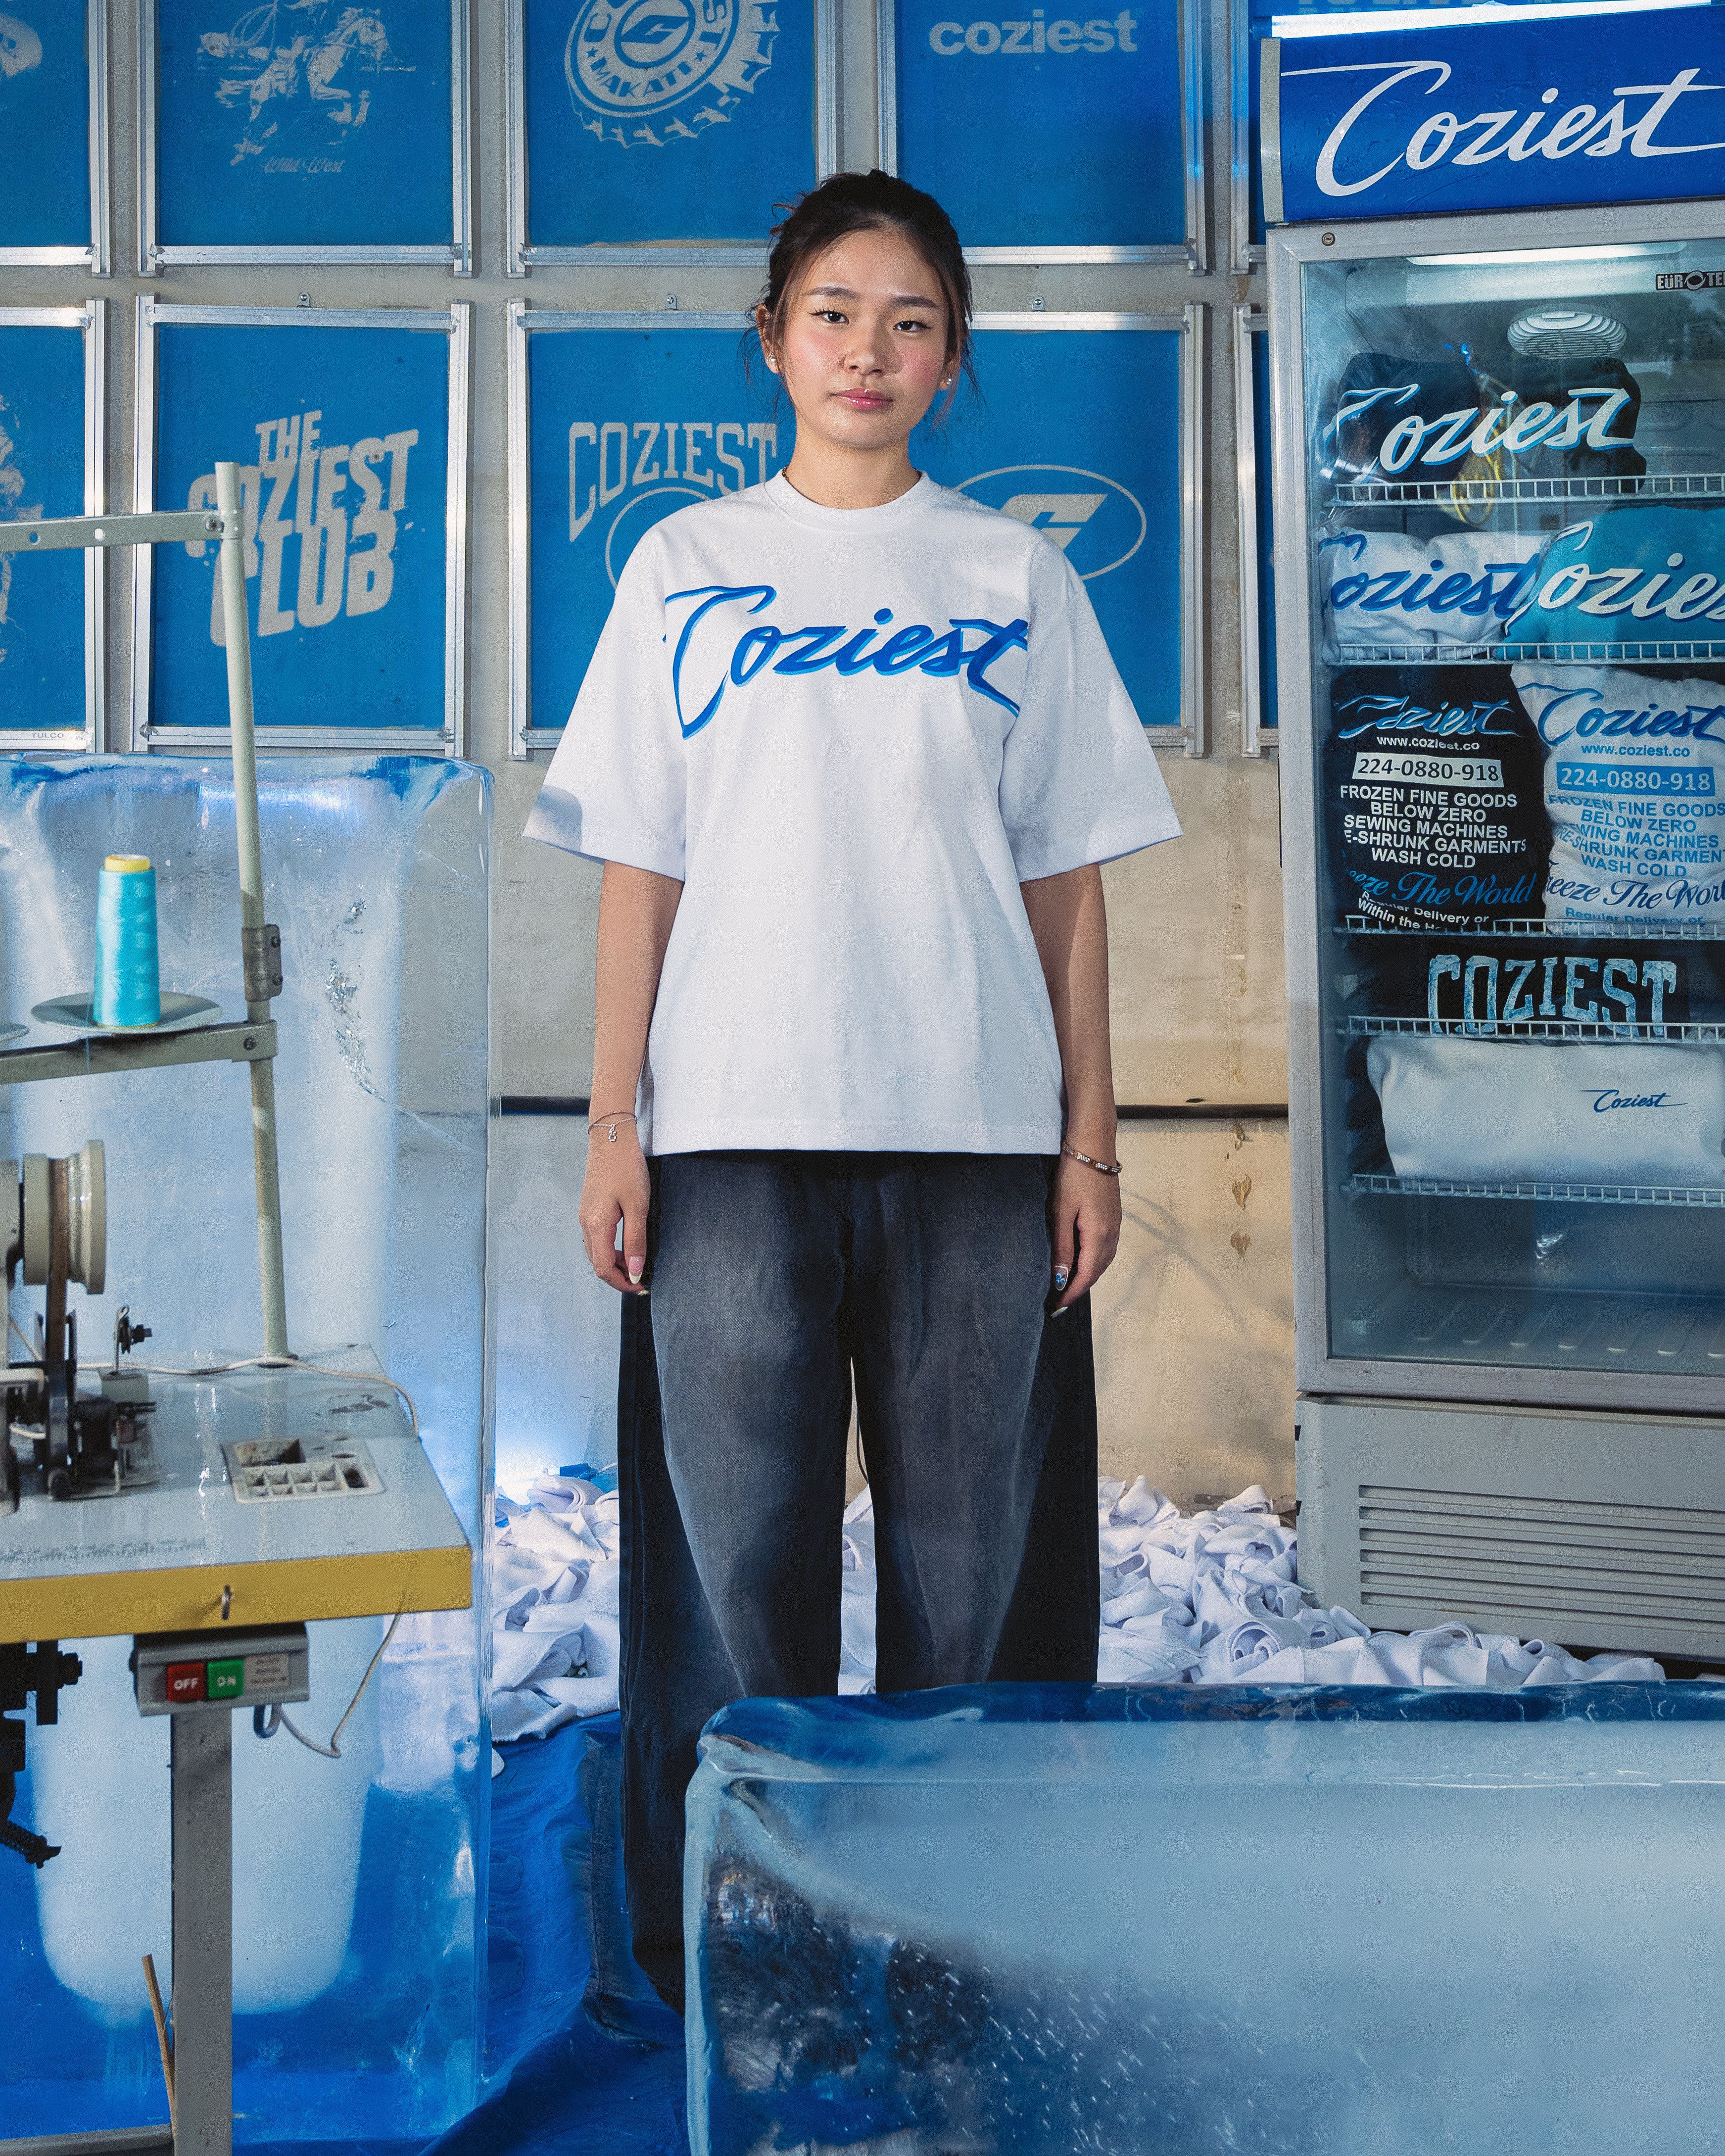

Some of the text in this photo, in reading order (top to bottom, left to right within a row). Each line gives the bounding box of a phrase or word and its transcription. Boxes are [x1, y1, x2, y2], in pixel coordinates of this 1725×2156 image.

[929, 9, 1138, 55] coziest
[590, 56, 693, 98] MAKATI
[1281, 60, 1725, 197] Coziest
[302, 156, 346, 174] West
[255, 410, 323, 465] THE
[569, 422, 777, 543] COZIEST
[663, 585, 1029, 740] Coziest
[1518, 682, 1725, 746] Coziest
[1377, 736, 1480, 751] www.coziest.co
[1581, 744, 1690, 758] www.coziest.co
[1357, 758, 1499, 781] 224-0880-918
[1561, 767, 1711, 791] 224-0880-918
[1341, 785, 1517, 808] FROZEN FINE GOODS
[1549, 794, 1725, 817] FROZEN FINE GOODS
[1371, 802, 1486, 822] BELOW ZERO
[1581, 809, 1697, 833] BELOW ZERO
[1344, 814, 1508, 838] SEWING MACHINES
[1435, 838, 1526, 854] GARMENTS
[1626, 831, 1720, 849] MACHINES
[1371, 847, 1476, 868] WASH COLD
[1581, 853, 1687, 877] WASH COLD
[1644, 848, 1725, 863] GARMEN
[1391, 871, 1451, 905] The
[1455, 872, 1537, 906] World
[1603, 879, 1663, 910] The
[1358, 898, 1420, 929] Within the
[1413, 907, 1470, 926] Delivery
[1428, 955, 1677, 1036] COZIEST
[1580, 1089, 1688, 1113] Coziest
[174, 1677, 198, 1691] OFF
[216, 1676, 237, 1687] ON
